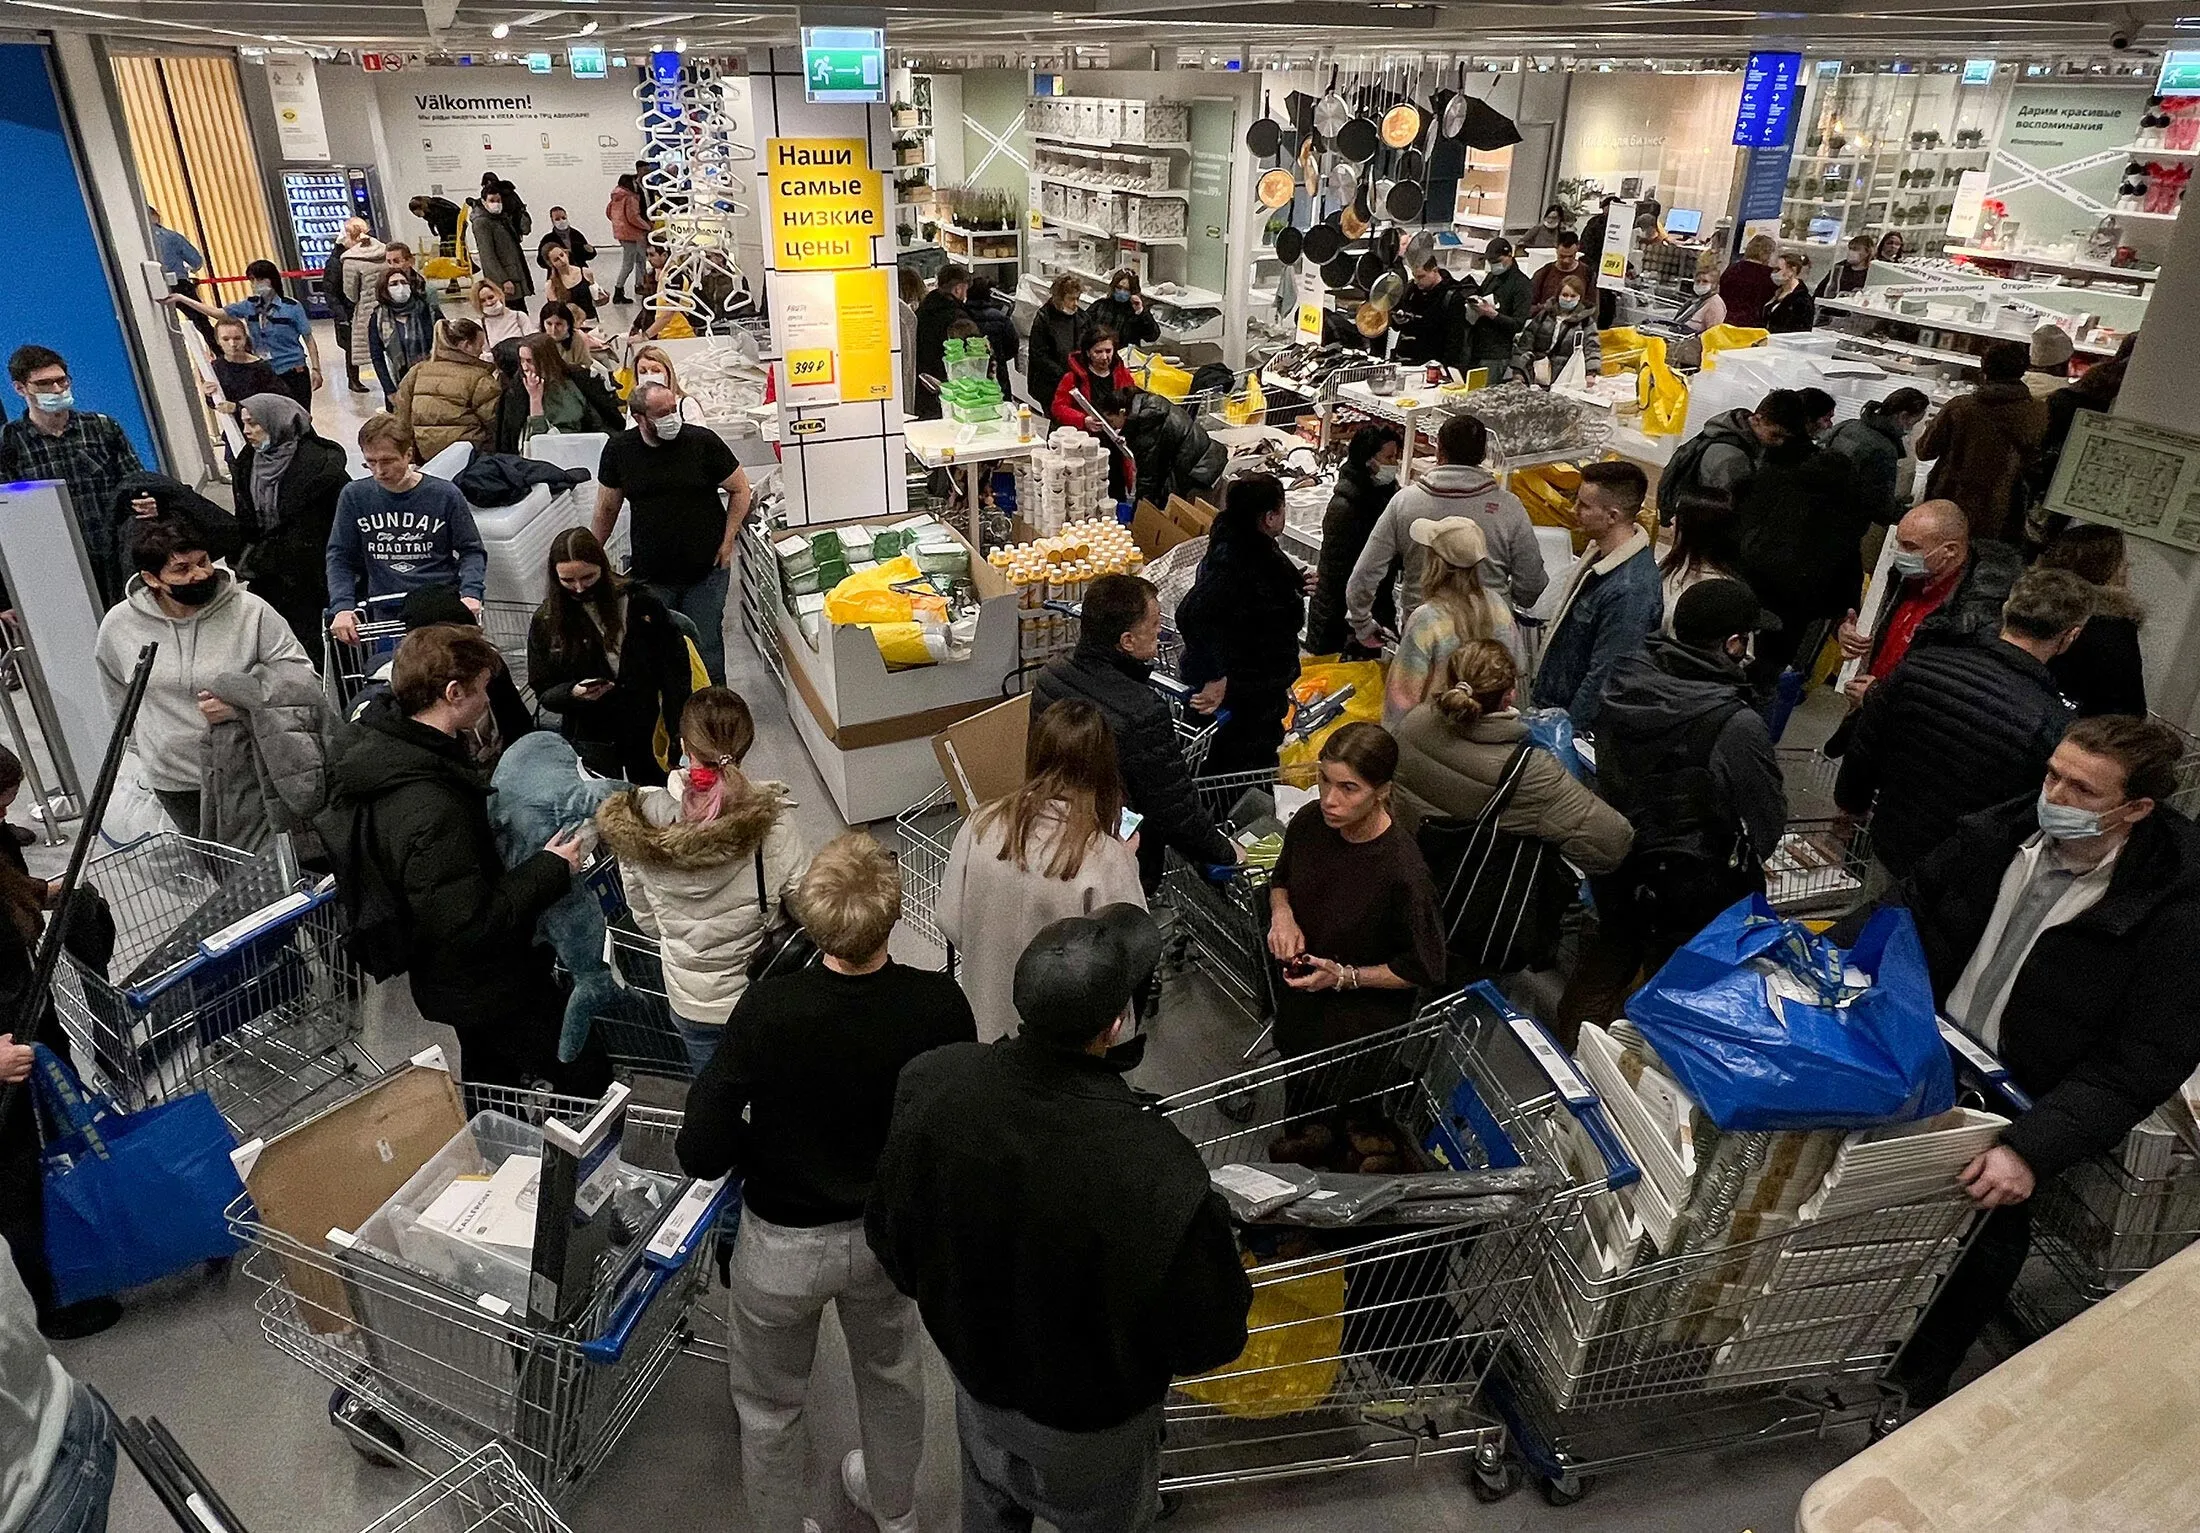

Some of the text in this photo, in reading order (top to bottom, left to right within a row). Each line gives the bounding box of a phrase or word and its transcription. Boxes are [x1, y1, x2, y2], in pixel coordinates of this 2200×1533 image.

[414, 94, 532, 110] Välkommen!
[2018, 105, 2121, 118] Дарим красивые
[2015, 120, 2104, 131] воспоминания
[778, 145, 851, 166] Наши
[781, 179, 862, 196] самые
[783, 209, 874, 226] низкие
[785, 240, 850, 261] цены
[794, 361, 814, 375] 399
[792, 421, 824, 432] IKEA
[357, 511, 446, 534] SUNDAY
[368, 541, 434, 553] ROAD TRIP
